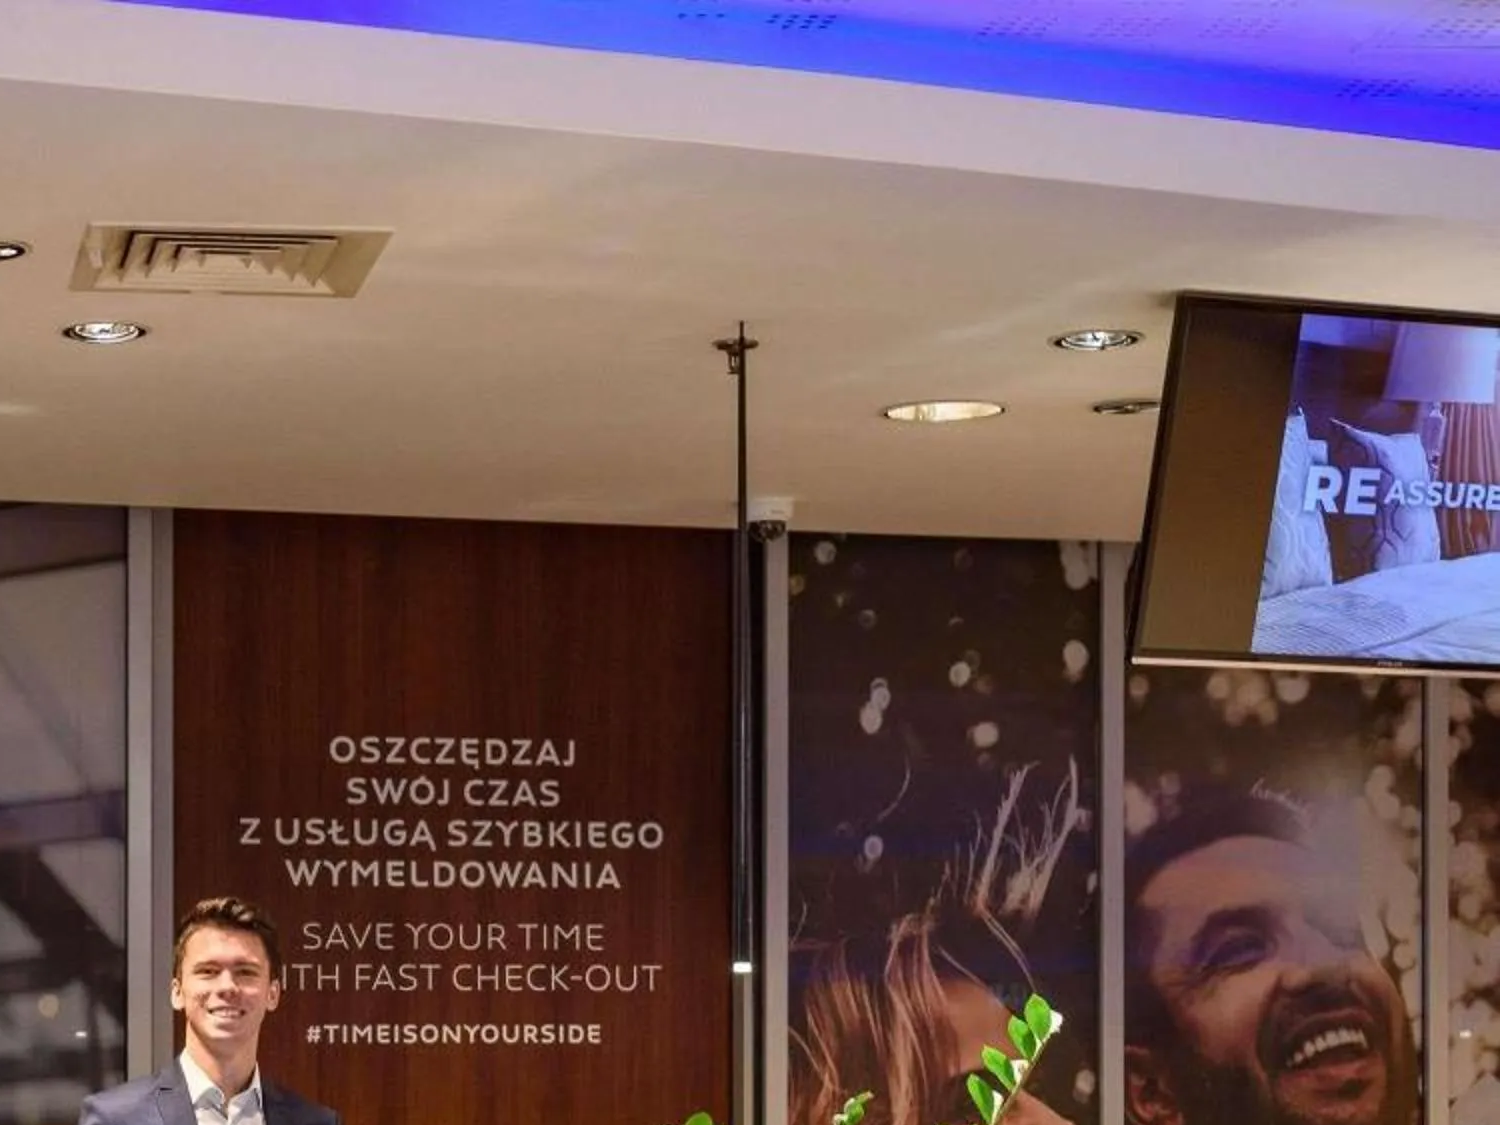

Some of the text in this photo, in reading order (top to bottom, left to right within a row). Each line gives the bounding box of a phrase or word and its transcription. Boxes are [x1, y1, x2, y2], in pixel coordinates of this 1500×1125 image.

[1303, 465, 1381, 515] RE
[329, 735, 575, 770] OSZCZĘDZAJ
[347, 775, 560, 807] SWÓJ CZAS
[239, 817, 664, 851] Z USŁUGĄ SZYBKIEGO
[285, 859, 621, 889] WYMELDOWANIA
[303, 922, 604, 951] SAVE YOUR TIME
[281, 963, 663, 993] ITH FAST CHECK-OUT
[305, 1023, 602, 1045] #TIMEISONYOURSIDE
